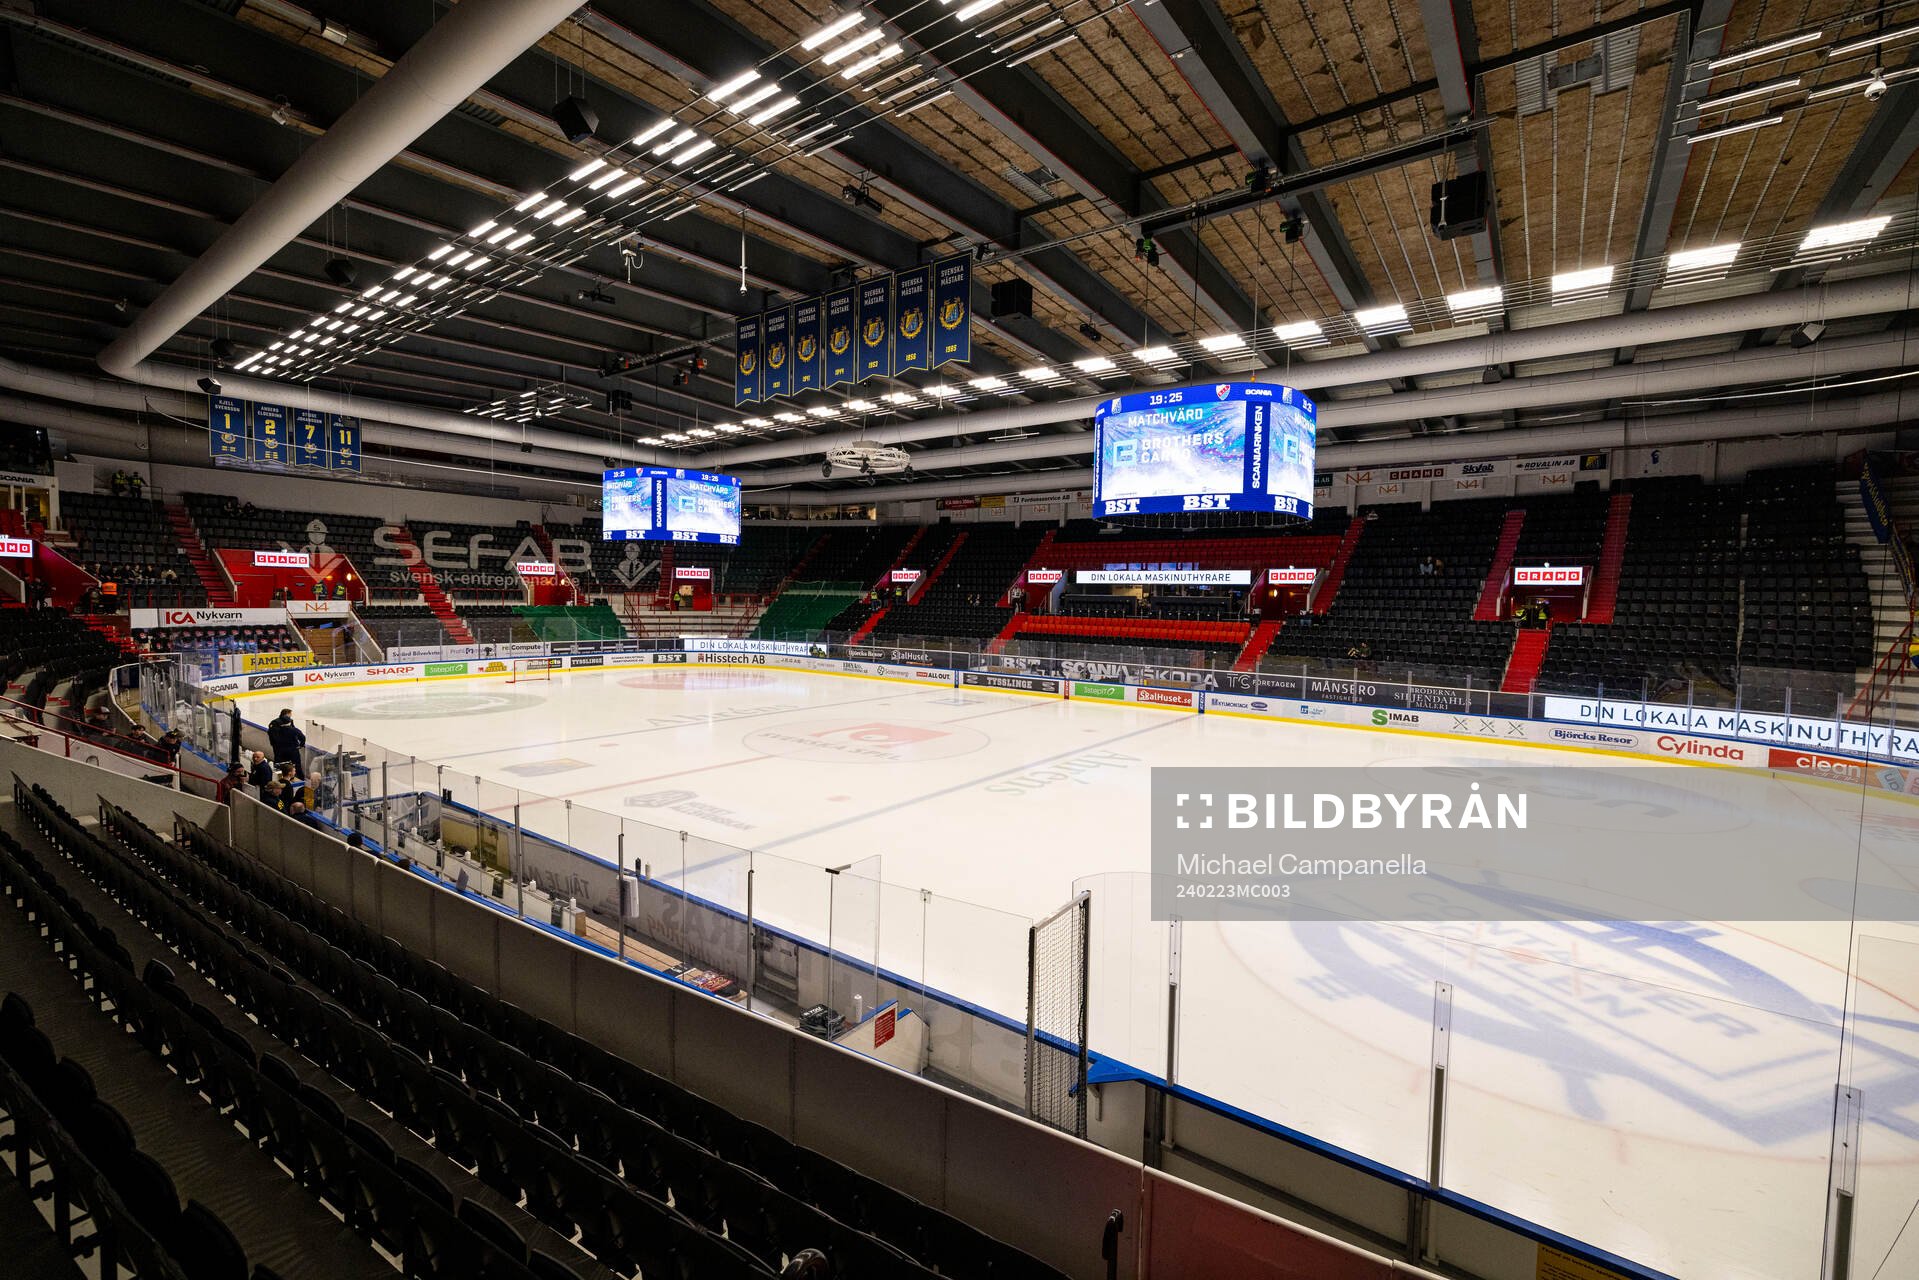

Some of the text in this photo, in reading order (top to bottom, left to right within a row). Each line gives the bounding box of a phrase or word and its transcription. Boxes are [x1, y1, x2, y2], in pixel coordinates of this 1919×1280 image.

[941, 266, 963, 278] SVENSKA
[902, 277, 922, 288] SVENSKA
[940, 274, 964, 286] MÄSTARE
[864, 288, 884, 298] SVENSKA
[902, 284, 923, 296] MÄSTARE
[831, 298, 849, 308] SVENSKA
[864, 295, 884, 305] MÄSTARE
[798, 307, 816, 317] SVENSKA
[831, 305, 849, 316] MÄSTARE
[769, 316, 784, 325] SVENSKA
[798, 314, 816, 324] MÄSTARE
[1150, 393, 1182, 405] 19:25
[224, 414, 230, 429] 1
[1128, 408, 1203, 427] MATCHVÄRD
[265, 420, 276, 434] 2
[305, 425, 315, 439] 7
[340, 430, 351, 445] 11
[1142, 433, 1224, 449] BROTHERS
[1252, 406, 1263, 488] SCANIARINKEN
[1525, 461, 1560, 469] ROVALIN
[1346, 472, 1372, 484] N4
[1390, 469, 1443, 479] CRAMO
[1542, 474, 1568, 484] N4
[1379, 485, 1399, 494] N4
[1456, 479, 1479, 489] N4
[1105, 499, 1140, 514] BST
[1183, 495, 1230, 510] BST
[1274, 497, 1297, 513] BST
[626, 531, 645, 539] BST
[673, 532, 698, 541] BST
[258, 555, 308, 564] CRAMO
[1091, 573, 1231, 582] DIN LOKALA MASKINUTHYRARE
[1271, 573, 1314, 581] CRAMO
[1518, 572, 1579, 580] CRAMO
[306, 602, 329, 612] N4
[166, 611, 242, 624] ICA Nykvarn
[718, 642, 748, 650] LOKALA
[251, 656, 306, 666] RAMIRENT
[705, 654, 765, 664] Hisstech AB
[305, 670, 355, 682] ICA Nykvarn
[367, 666, 414, 675] SHARP
[210, 683, 238, 693] SCANIA
[987, 677, 1032, 688] TYSSLINGE
[1372, 709, 1419, 725] SIMAB
[1581, 705, 1613, 718] DIN
[1623, 707, 1707, 728] LOKALA
[1554, 729, 1632, 745] Björcks Resor
[1657, 735, 1744, 761] Cylinda
[1796, 756, 1860, 777] clean
